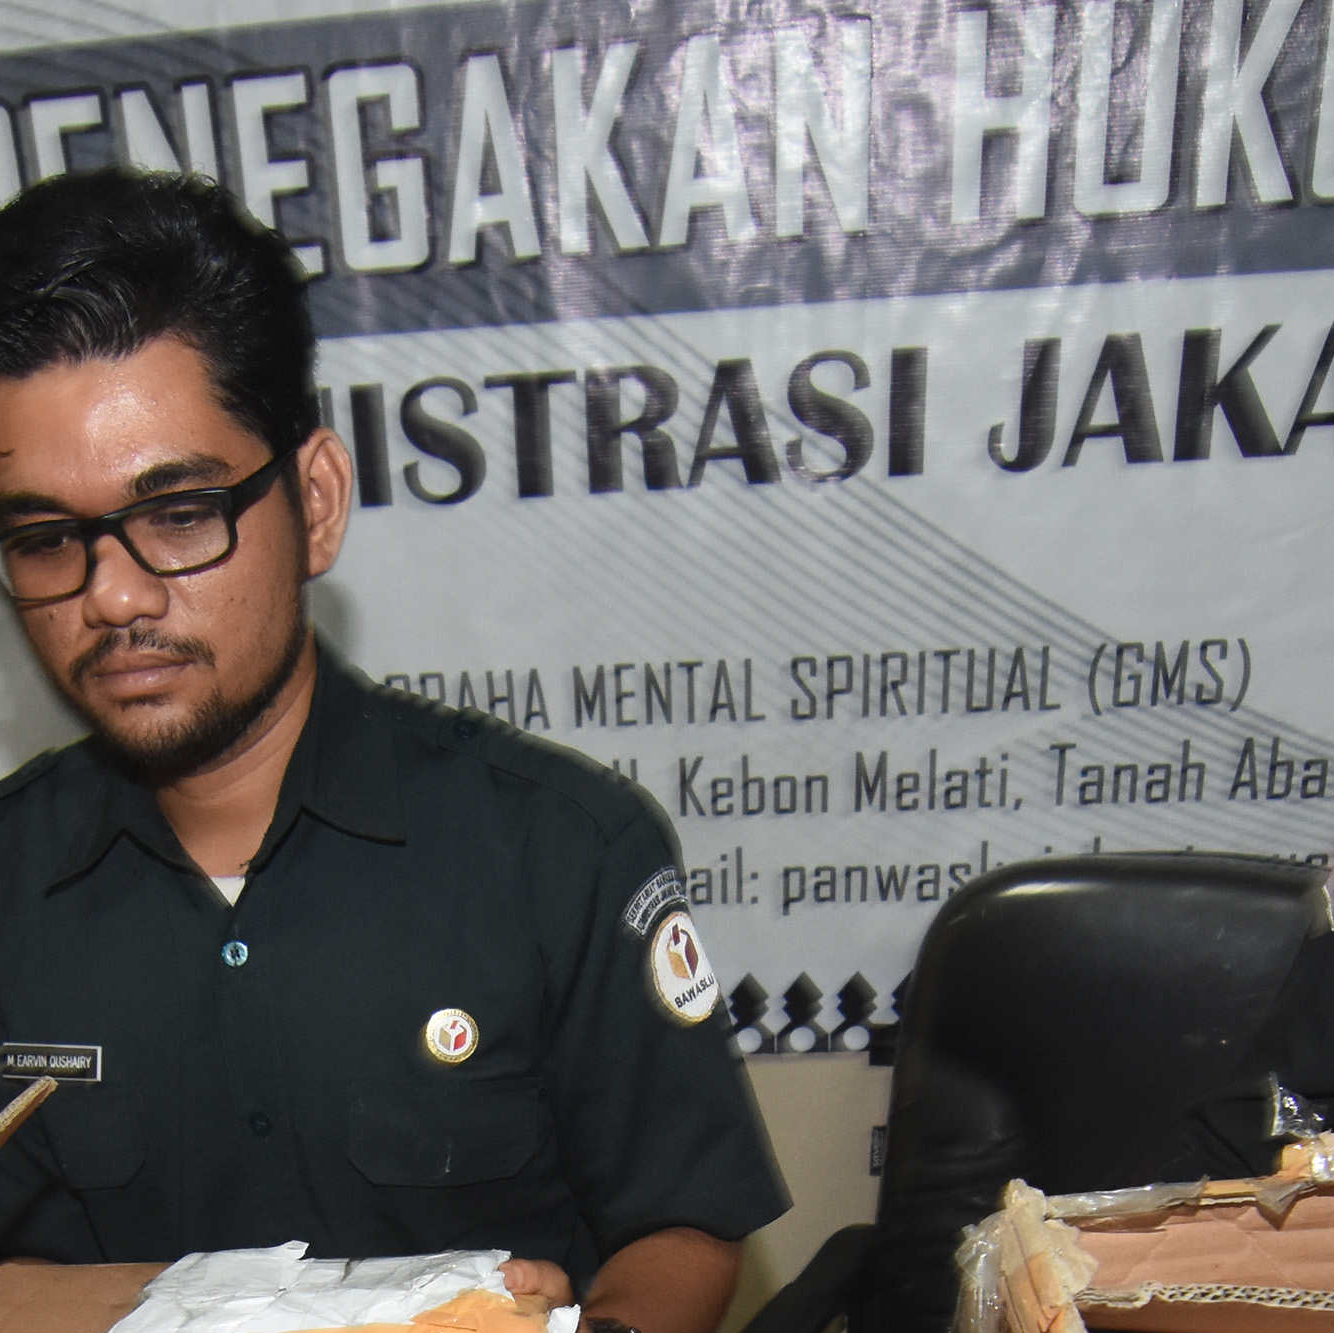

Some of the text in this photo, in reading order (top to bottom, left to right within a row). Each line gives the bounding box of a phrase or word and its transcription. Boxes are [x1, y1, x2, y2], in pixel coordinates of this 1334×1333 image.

[384, 638, 1253, 730] AHA MENTAL SPIRITUAL (GMS)
[678, 754, 829, 817] Kebon
[854, 747, 1024, 813] Melati,
[1049, 738, 1206, 806] Tanah
[687, 846, 760, 906] ail:
[674, 973, 715, 1008] BAWASLU
[17, 1054, 48, 1068] EARVIN
[49, 1056, 93, 1069] QUSHAIRY
